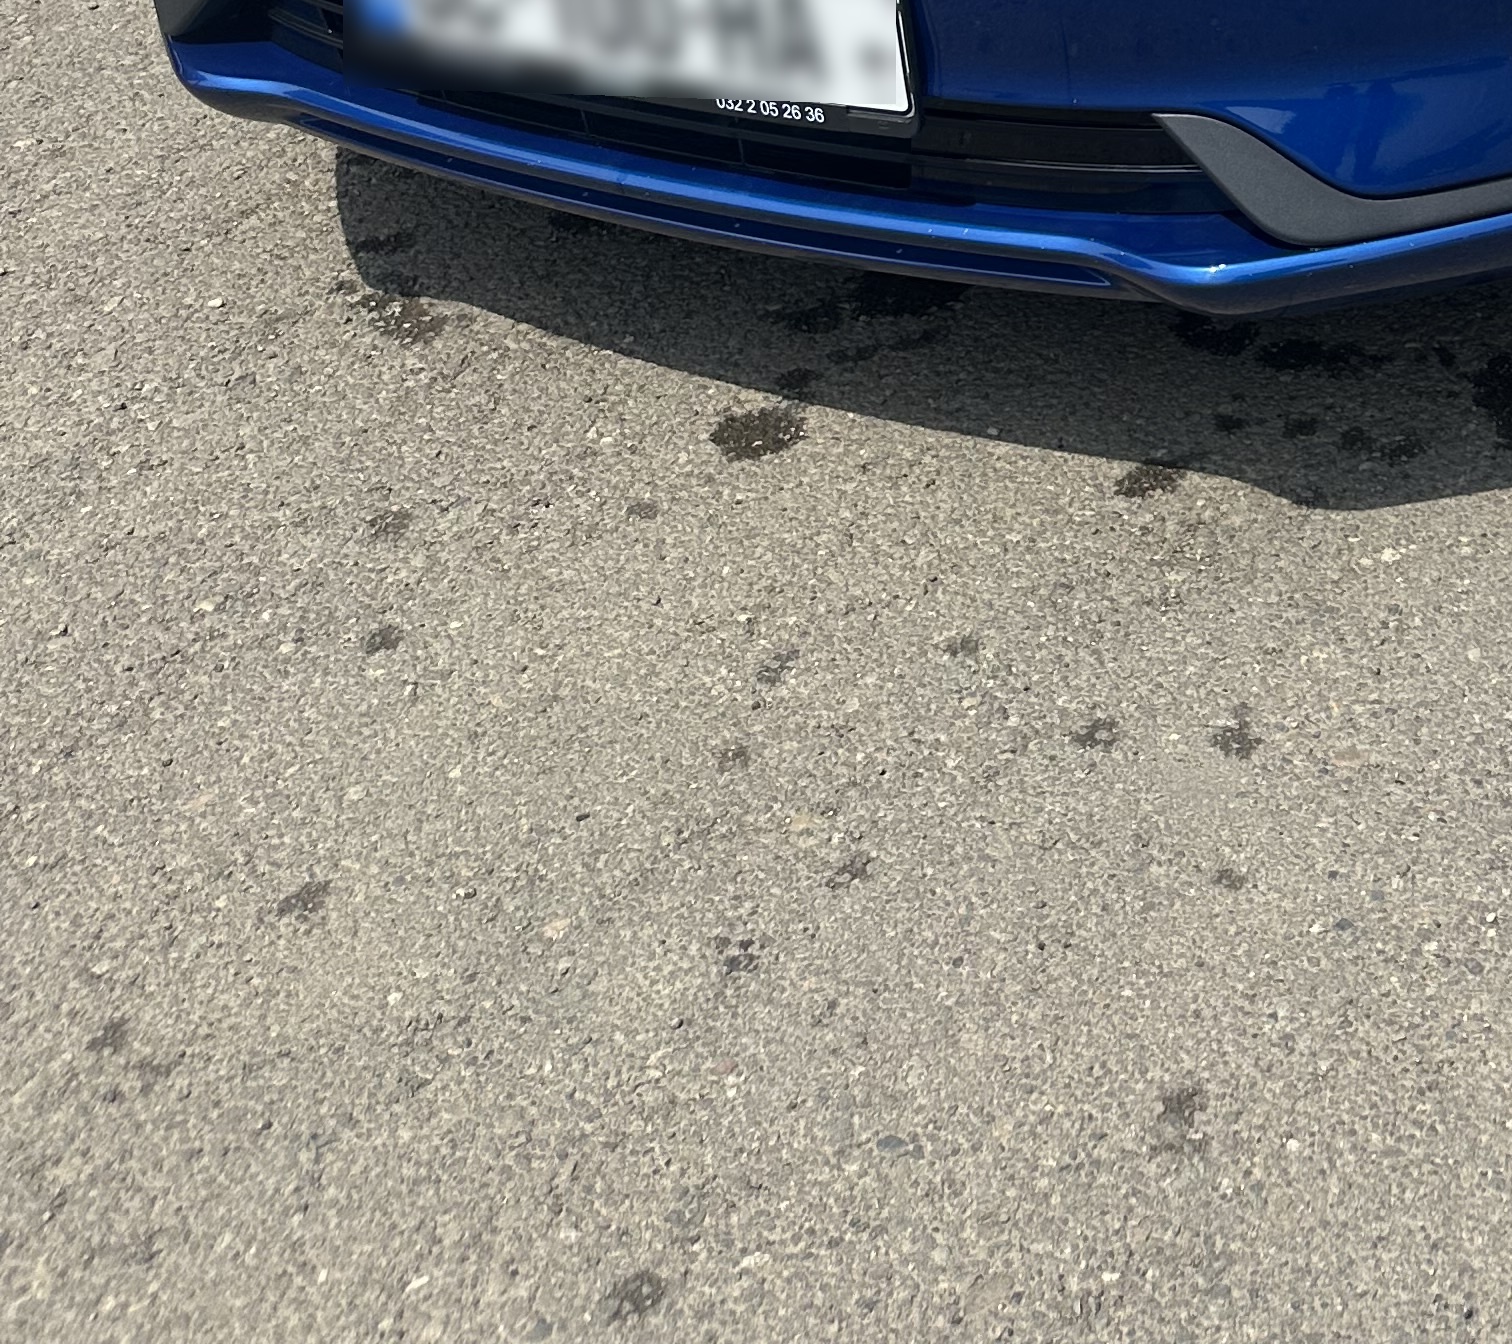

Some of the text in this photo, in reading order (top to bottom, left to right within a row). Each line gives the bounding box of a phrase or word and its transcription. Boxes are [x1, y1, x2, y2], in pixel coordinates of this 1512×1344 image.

[716, 98, 825, 123] 032 2 05 26 36
